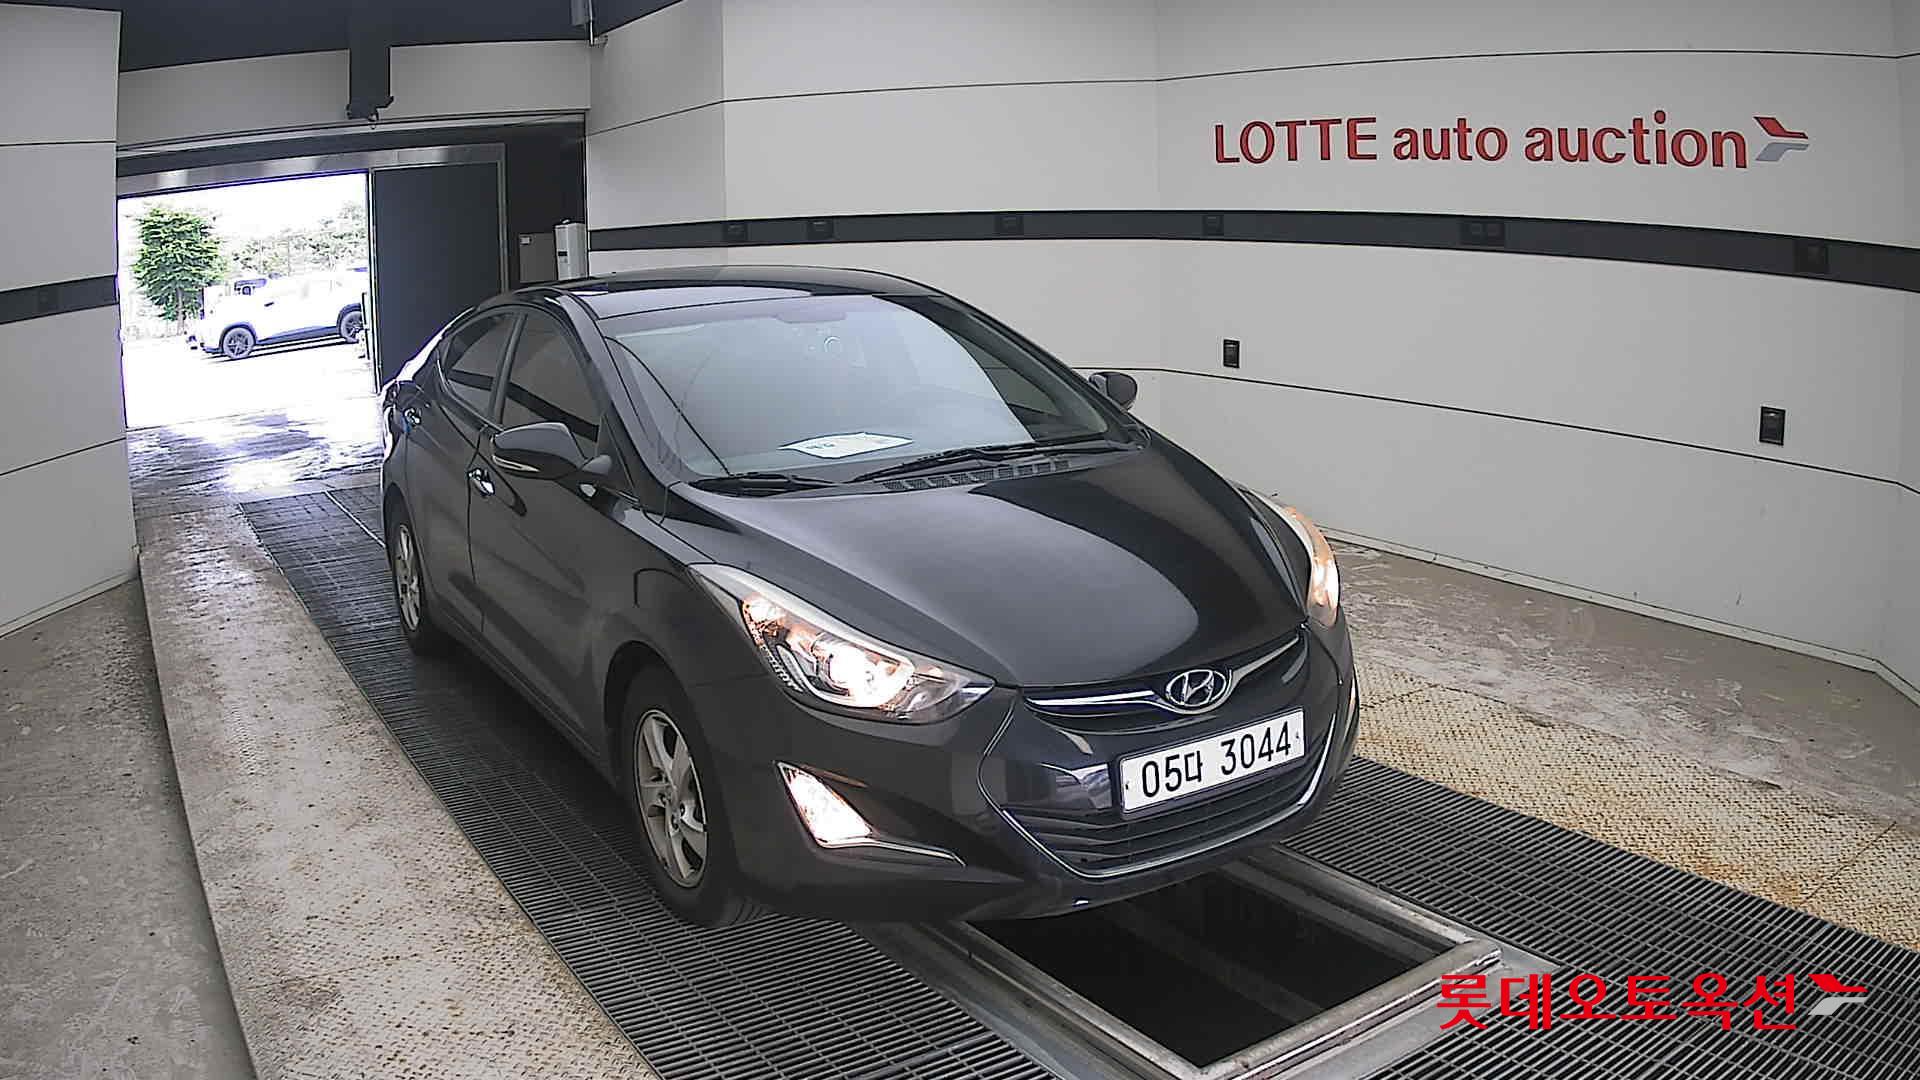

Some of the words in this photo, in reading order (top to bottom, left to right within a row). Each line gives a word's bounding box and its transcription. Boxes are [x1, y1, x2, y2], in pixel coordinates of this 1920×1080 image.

[1215, 117, 1377, 164] LOTTE
[1392, 118, 1509, 162] auto
[1524, 109, 1747, 168] auction
[1142, 750, 1203, 798] 05다
[1220, 721, 1291, 775] 3044
